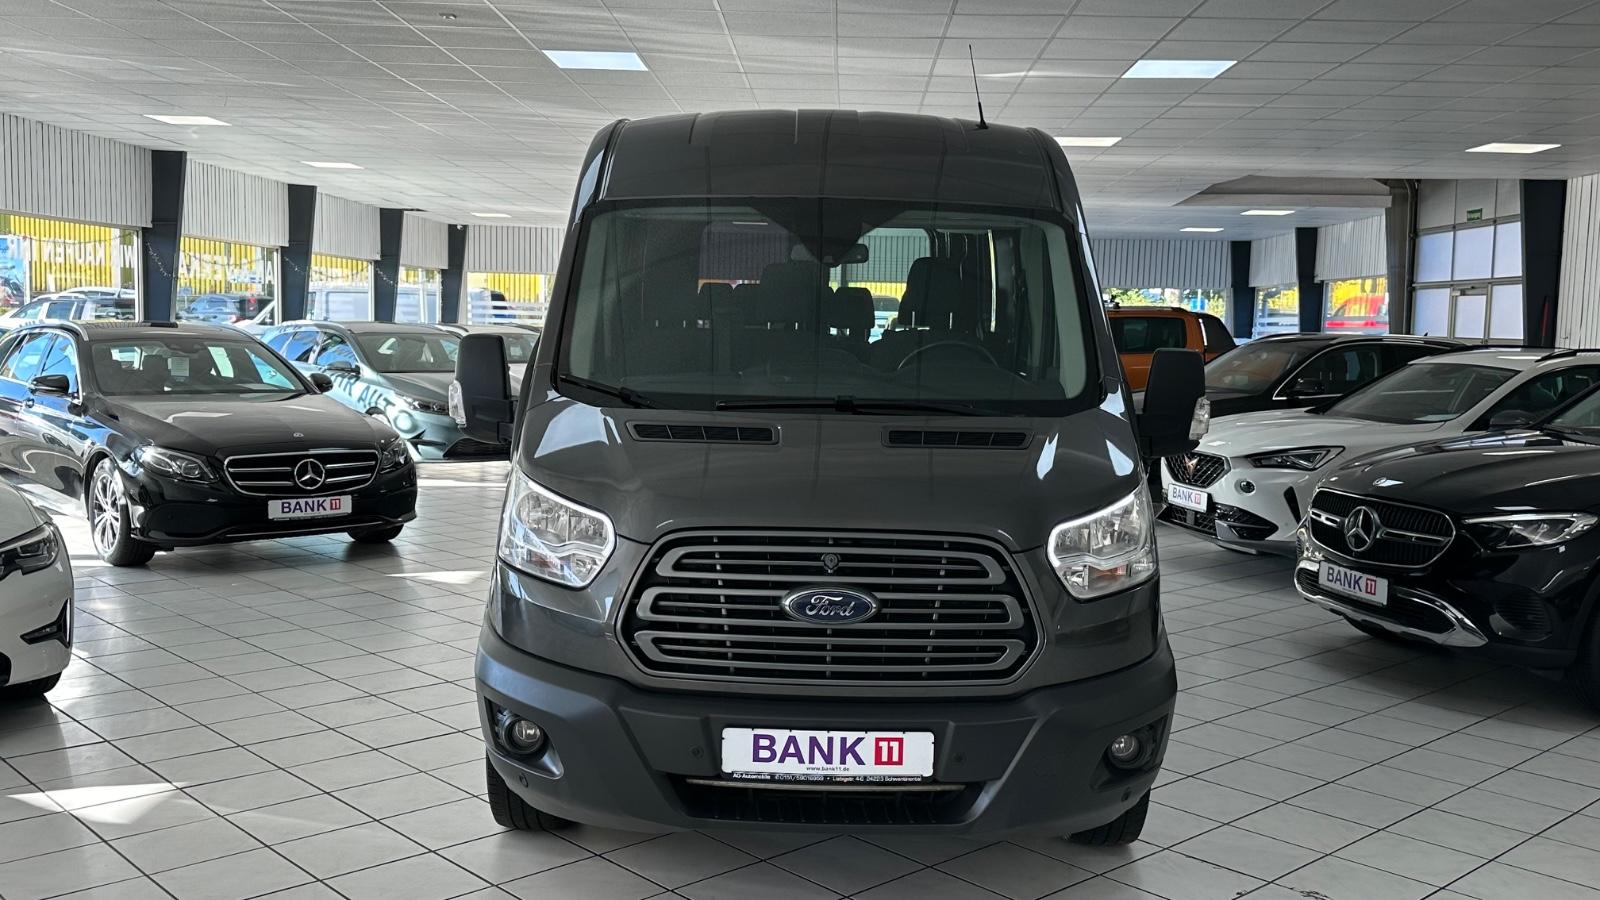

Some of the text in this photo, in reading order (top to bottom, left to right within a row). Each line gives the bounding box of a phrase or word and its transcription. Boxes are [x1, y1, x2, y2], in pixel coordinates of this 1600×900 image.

[281, 498, 340, 514] BANK 11
[1172, 487, 1194, 503] BANK
[1327, 566, 1363, 592] BANK
[1366, 578, 1376, 595] 11
[806, 594, 855, 616] Ford
[752, 733, 902, 766] BANK 11
